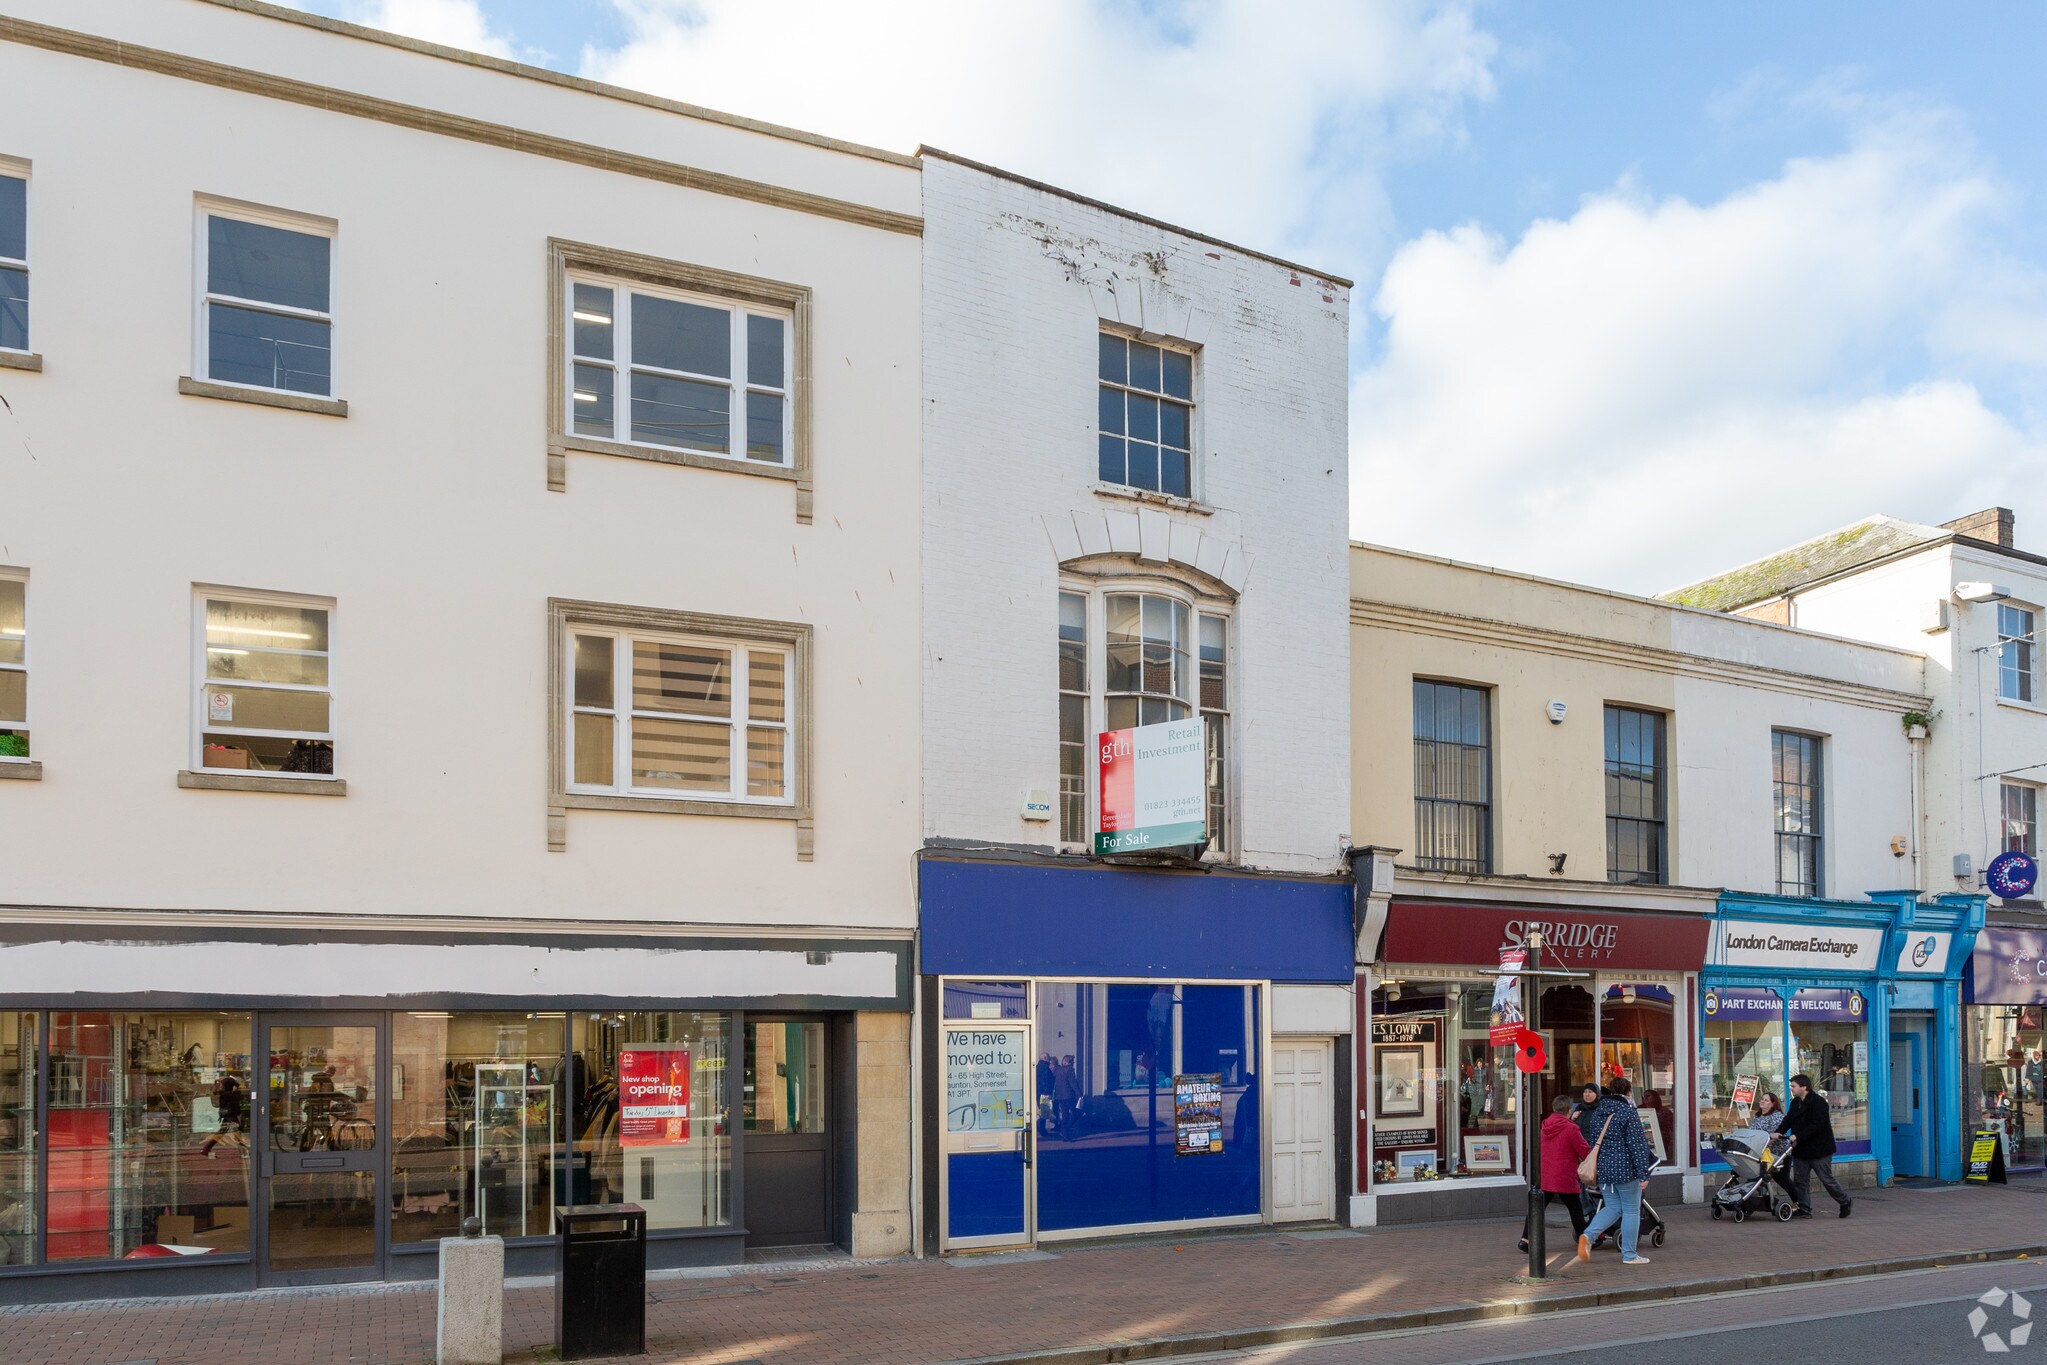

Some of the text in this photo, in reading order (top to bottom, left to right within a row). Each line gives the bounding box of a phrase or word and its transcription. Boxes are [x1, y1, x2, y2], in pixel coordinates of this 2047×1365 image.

[1168, 725, 1201, 740] Retail
[1101, 738, 1131, 764] gth
[1138, 740, 1201, 760] Investment
[1027, 803, 1049, 811] SECOM
[1144, 795, 1201, 811] 01823 334455
[1172, 806, 1201, 818] gth.net
[1102, 832, 1150, 849] For Sale
[1727, 933, 1858, 958] London Camera Exchange
[1722, 999, 1842, 1011] PART EXCHANGE WELCOME
[1389, 1024, 1423, 1035] LOWRY
[947, 1032, 1006, 1045] We have
[997, 1050, 1017, 1065] to:
[622, 1075, 660, 1084] New shop
[957, 1071, 968, 1080] 65
[968, 1071, 985, 1080] High
[985, 1070, 1009, 1079] Street,
[629, 1082, 683, 1098] opening
[973, 1079, 1008, 1089] Somerset
[1177, 1083, 1211, 1094] AMATEUR
[1193, 1092, 1221, 1103] BOXING
